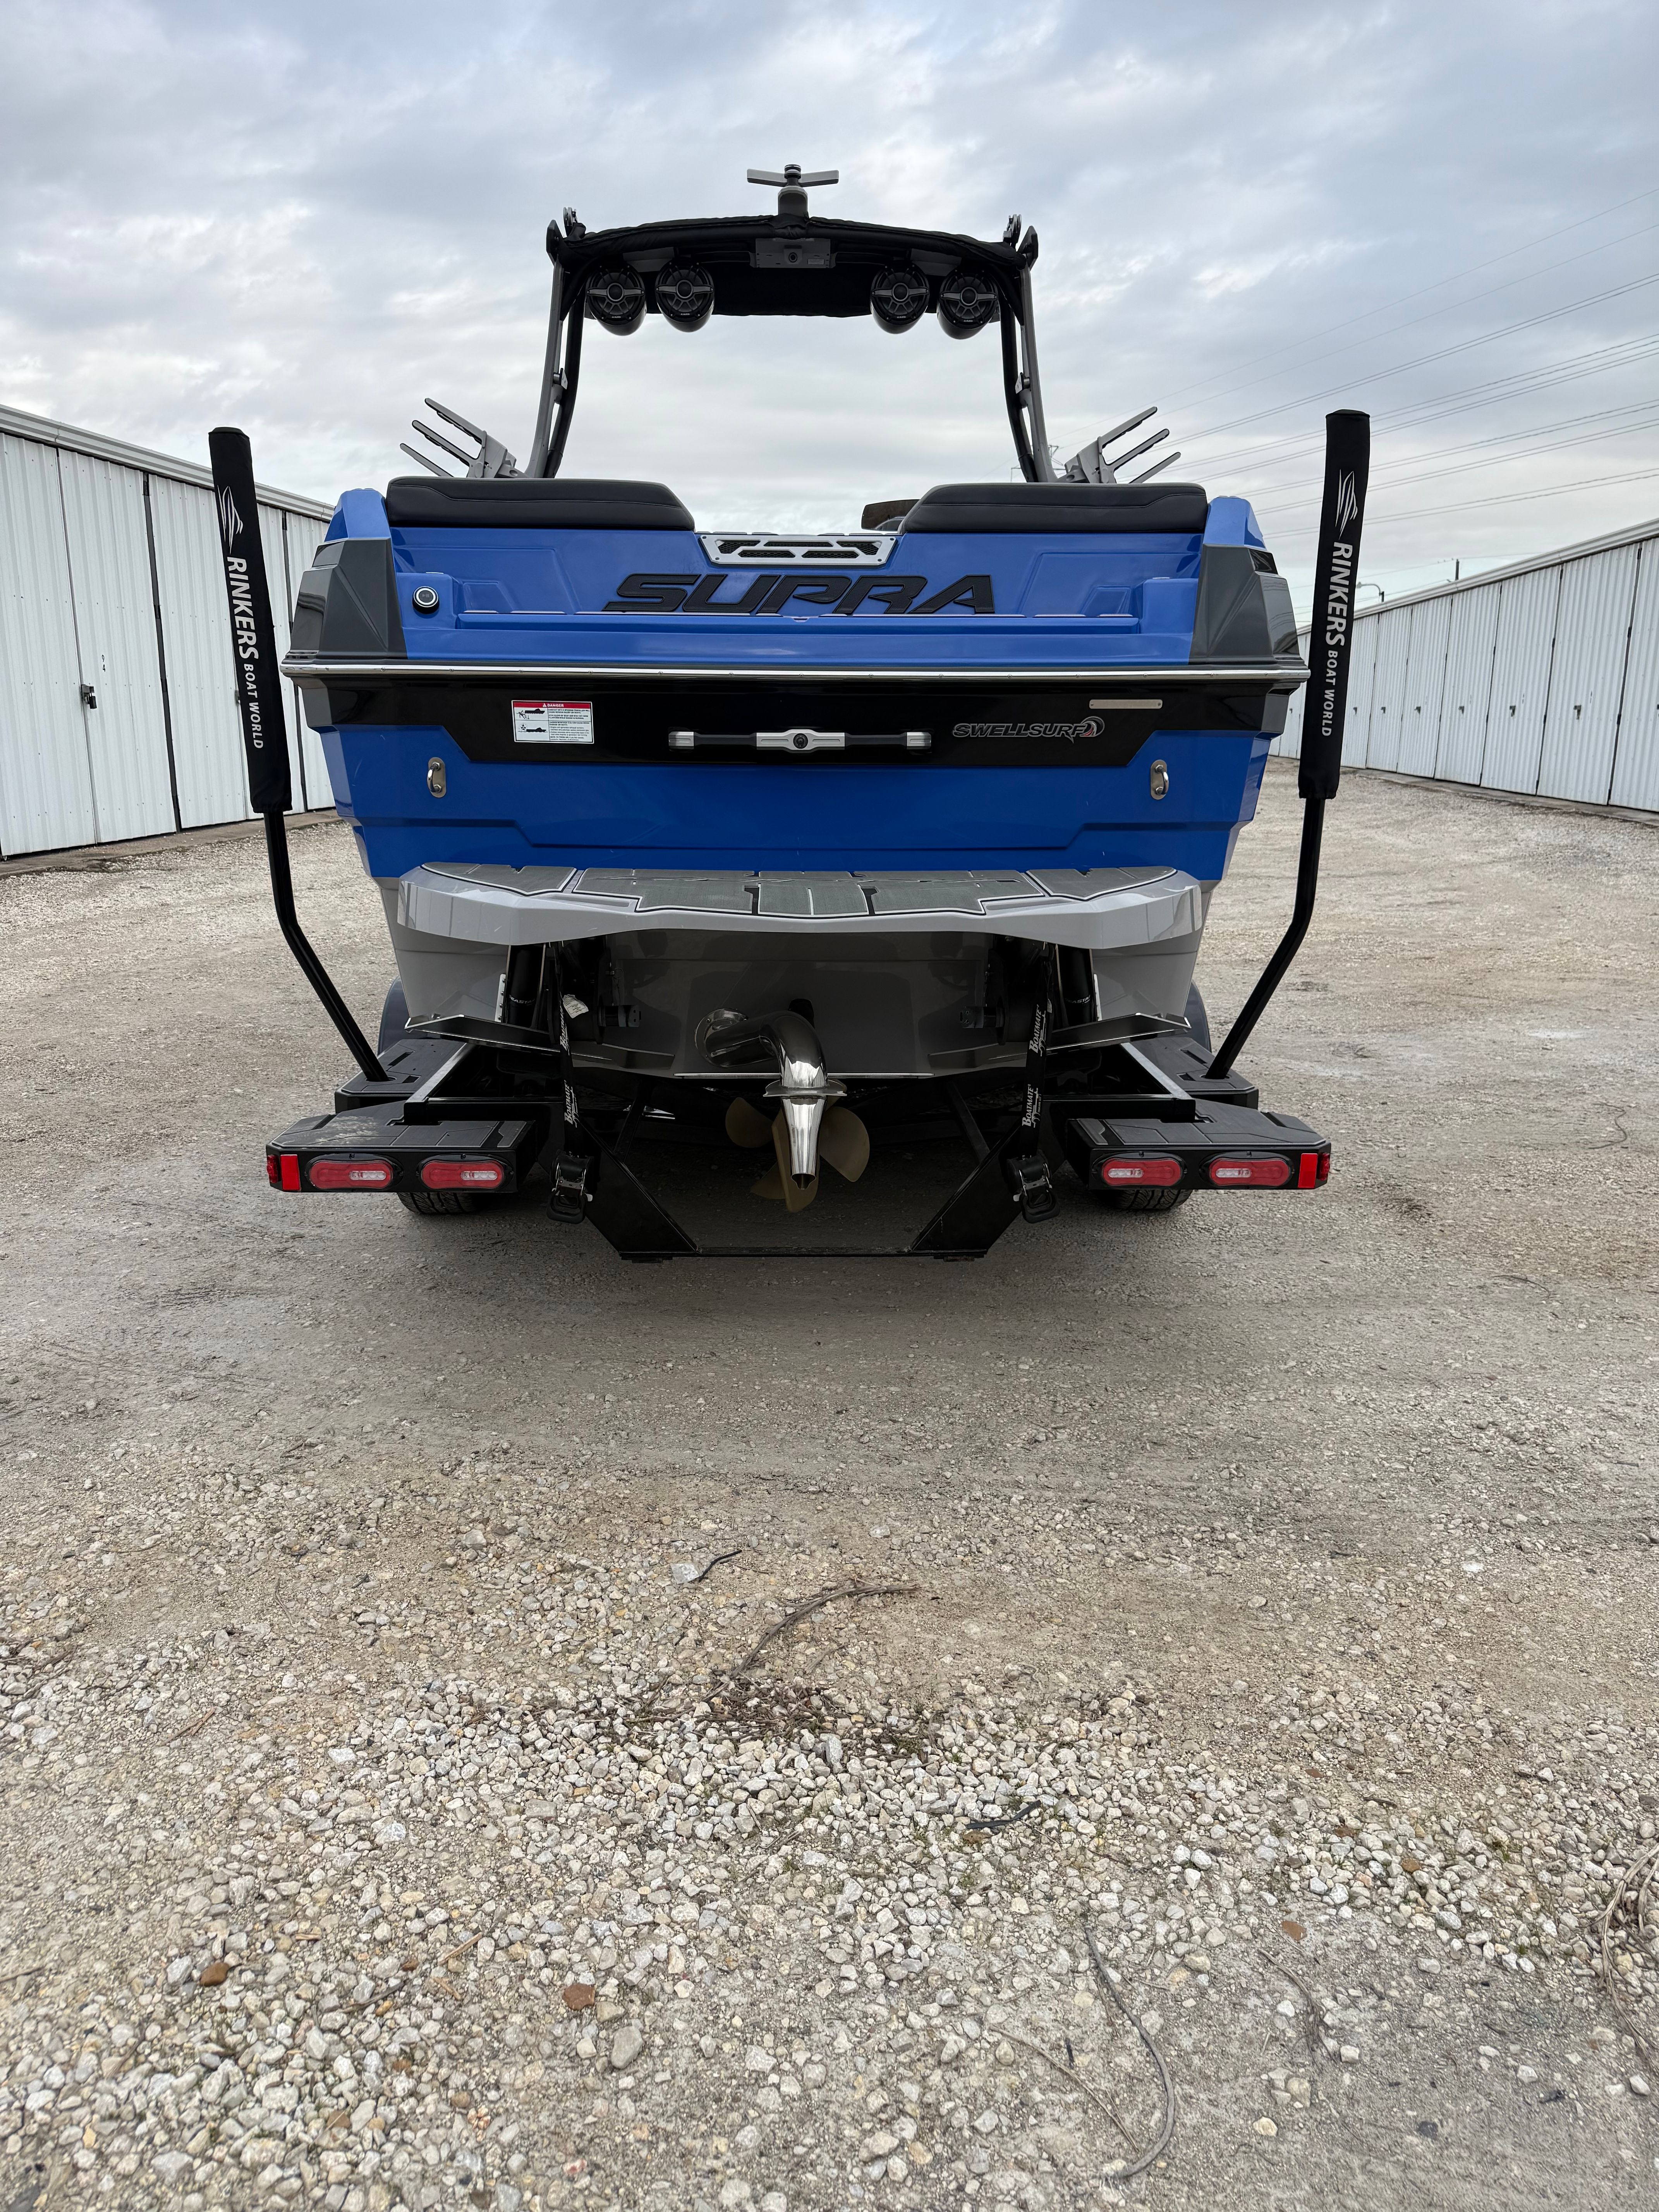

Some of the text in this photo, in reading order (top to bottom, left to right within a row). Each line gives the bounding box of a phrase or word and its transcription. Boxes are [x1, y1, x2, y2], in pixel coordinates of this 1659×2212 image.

[602, 573, 995, 614] SUPRA
[227, 556, 263, 749] RINKERS BOAT WORLD
[1322, 542, 1352, 736] RINKERS BOAT WORLD
[952, 723, 1090, 744] SWELLSURF
[1029, 1008, 1042, 1054] BOATMATE
[1022, 1086, 1034, 1127] BOATMATE
